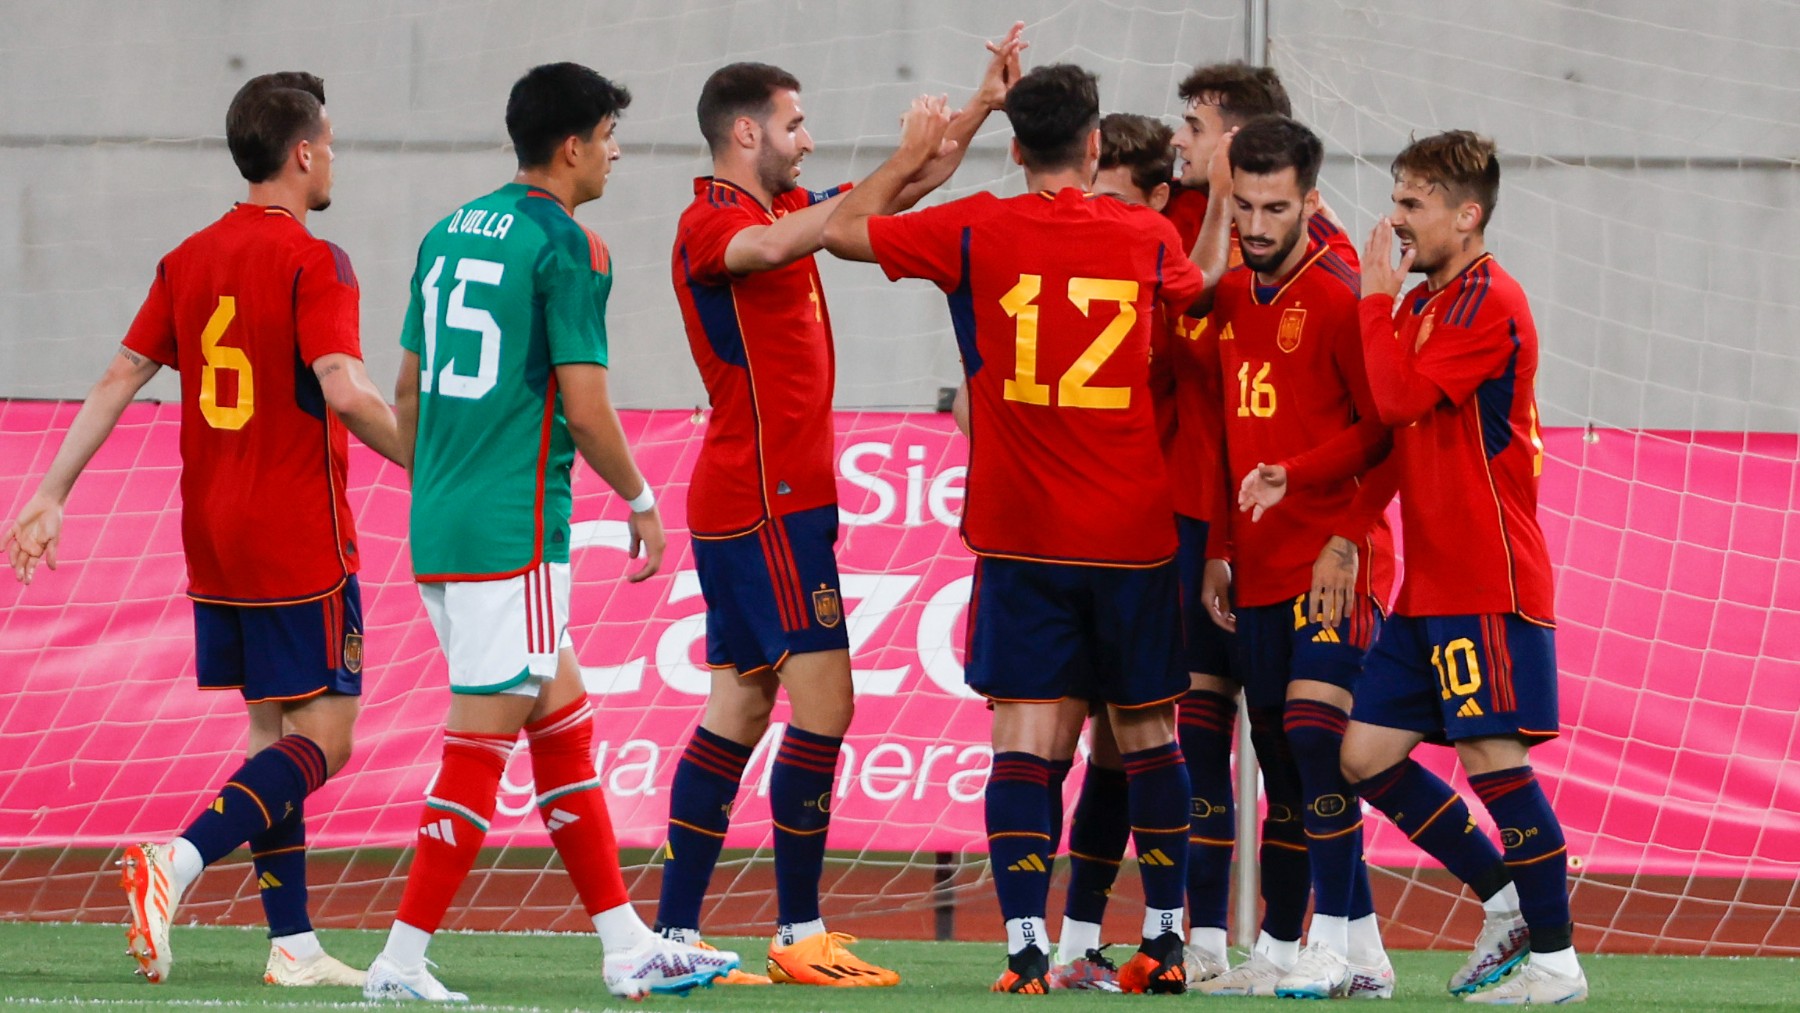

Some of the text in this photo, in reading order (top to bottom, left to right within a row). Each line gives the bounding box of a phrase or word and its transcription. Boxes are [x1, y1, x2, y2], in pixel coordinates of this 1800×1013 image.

[198, 295, 255, 430] 6
[421, 256, 505, 400] 15
[998, 273, 1140, 409] 12
[1237, 361, 1277, 417] 16
[1430, 637, 1482, 701] 10
